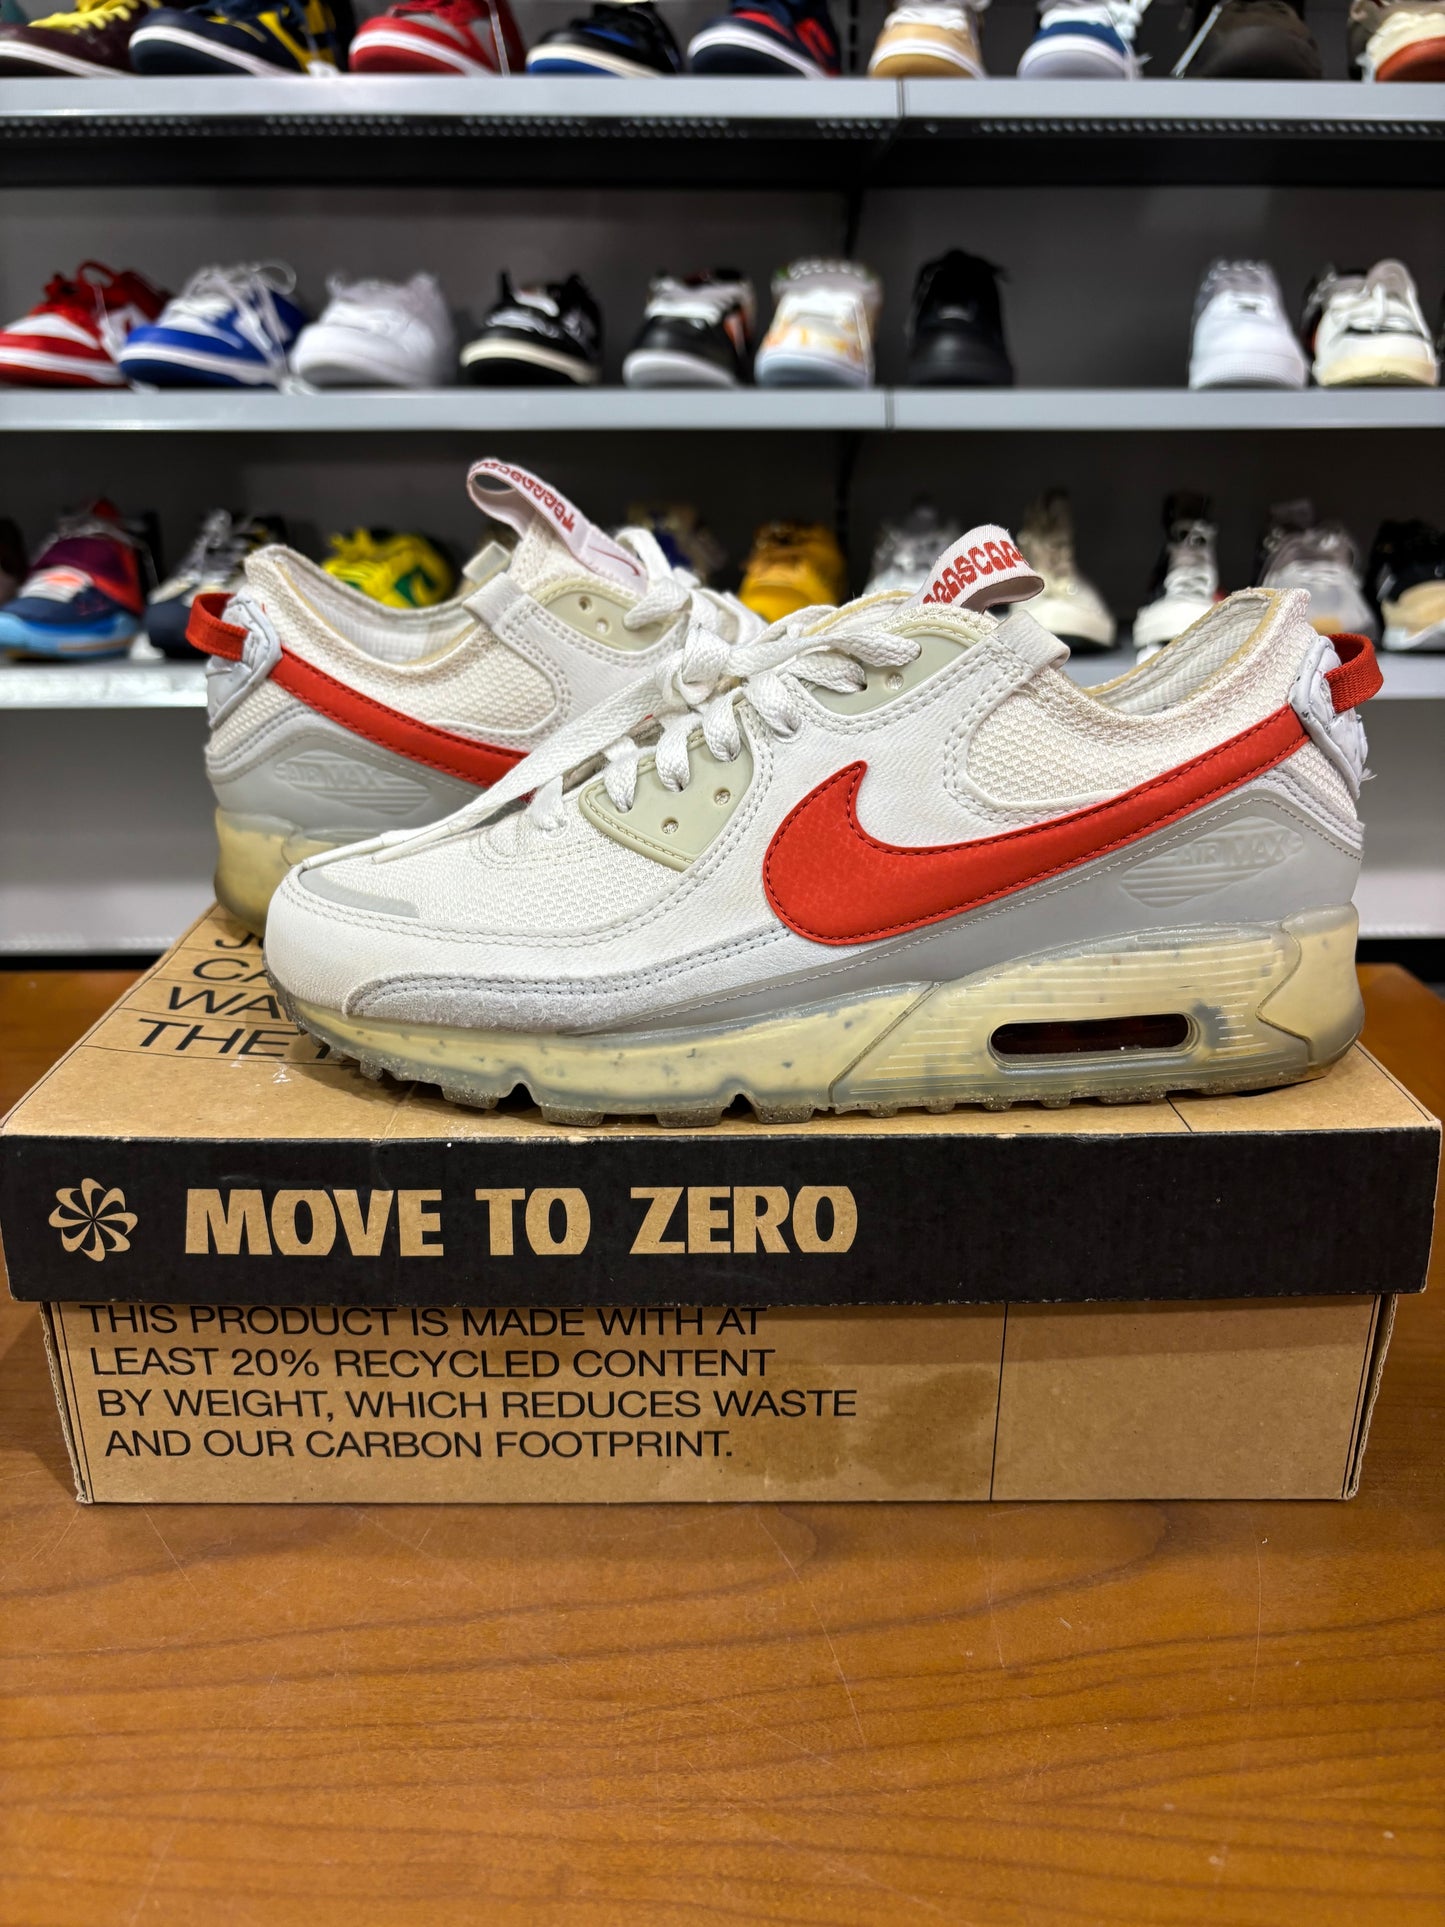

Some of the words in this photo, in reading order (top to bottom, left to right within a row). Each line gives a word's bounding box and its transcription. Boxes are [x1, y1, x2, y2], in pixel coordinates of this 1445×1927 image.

[139, 1018, 299, 1058] THE
[185, 1188, 444, 1257] MOVE
[475, 1187, 592, 1256] TO
[629, 1185, 859, 1255] ZERO
[80, 1304, 178, 1334] THIS
[190, 1305, 398, 1336] PRODUCT
[410, 1307, 449, 1337] IS
[462, 1307, 586, 1337] MADE
[597, 1307, 703, 1336] WITH
[716, 1307, 768, 1336] AT
[90, 1346, 219, 1376] LEAST
[231, 1348, 320, 1377] 20%
[334, 1349, 560, 1378] RECYCLED
[573, 1348, 776, 1377] CONTENT
[97, 1388, 152, 1417] BY
[163, 1389, 335, 1423] WEIGHT,
[345, 1390, 488, 1419] WHICH
[502, 1390, 701, 1418] REDUCES
[713, 1389, 858, 1417] WASTE
[105, 1429, 192, 1457] AND
[203, 1429, 295, 1457] OUR
[306, 1430, 482, 1458] CARBON
[496, 1429, 733, 1459] FOOTPRINT.
